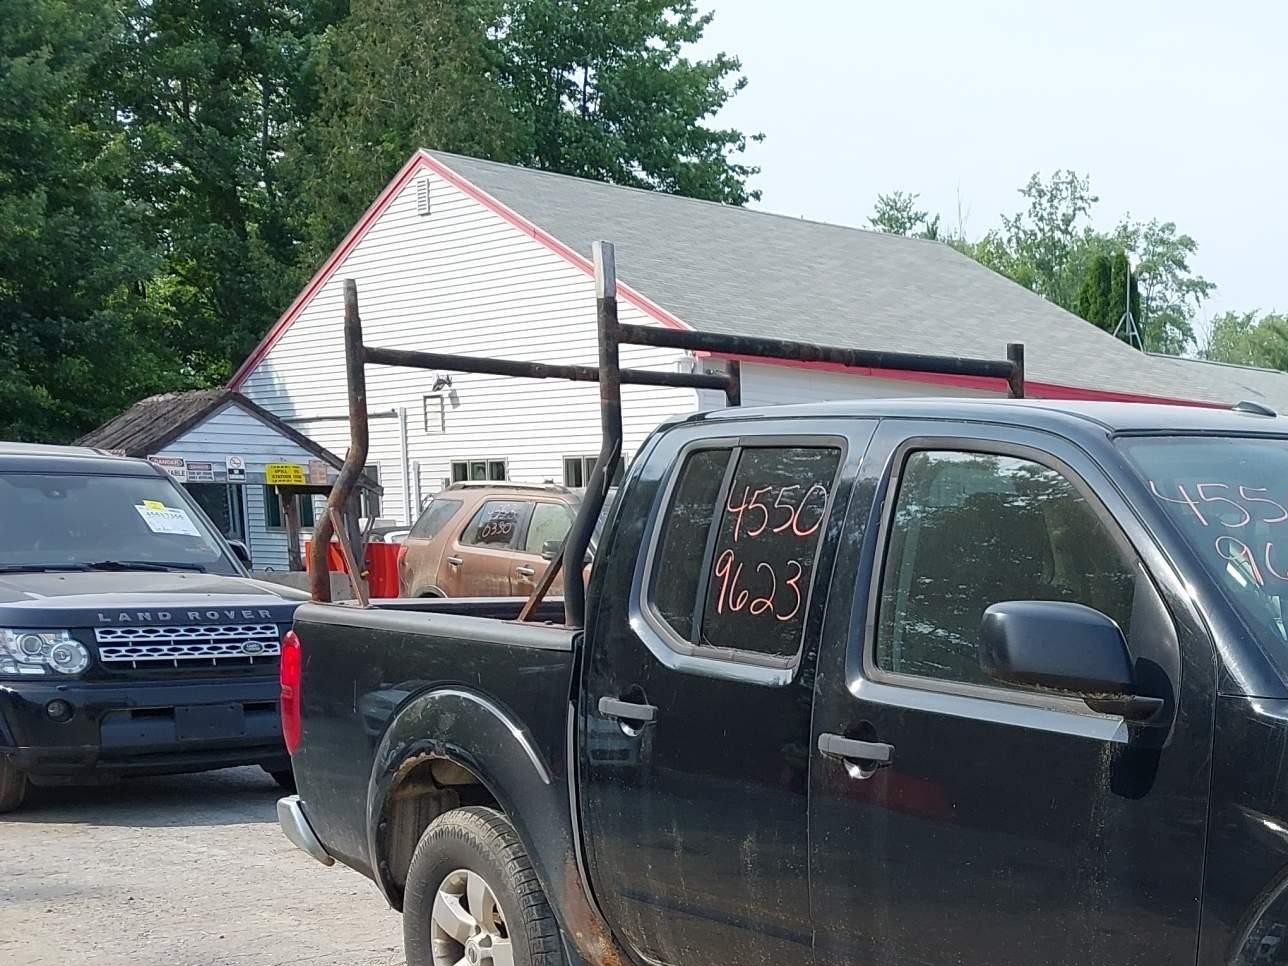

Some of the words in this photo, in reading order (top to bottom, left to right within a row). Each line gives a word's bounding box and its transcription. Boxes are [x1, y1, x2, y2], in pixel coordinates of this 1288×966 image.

[727, 479, 828, 542] 4550
[98, 611, 172, 622] LAND
[187, 609, 272, 620] ROVER
[716, 549, 802, 620] 9623
